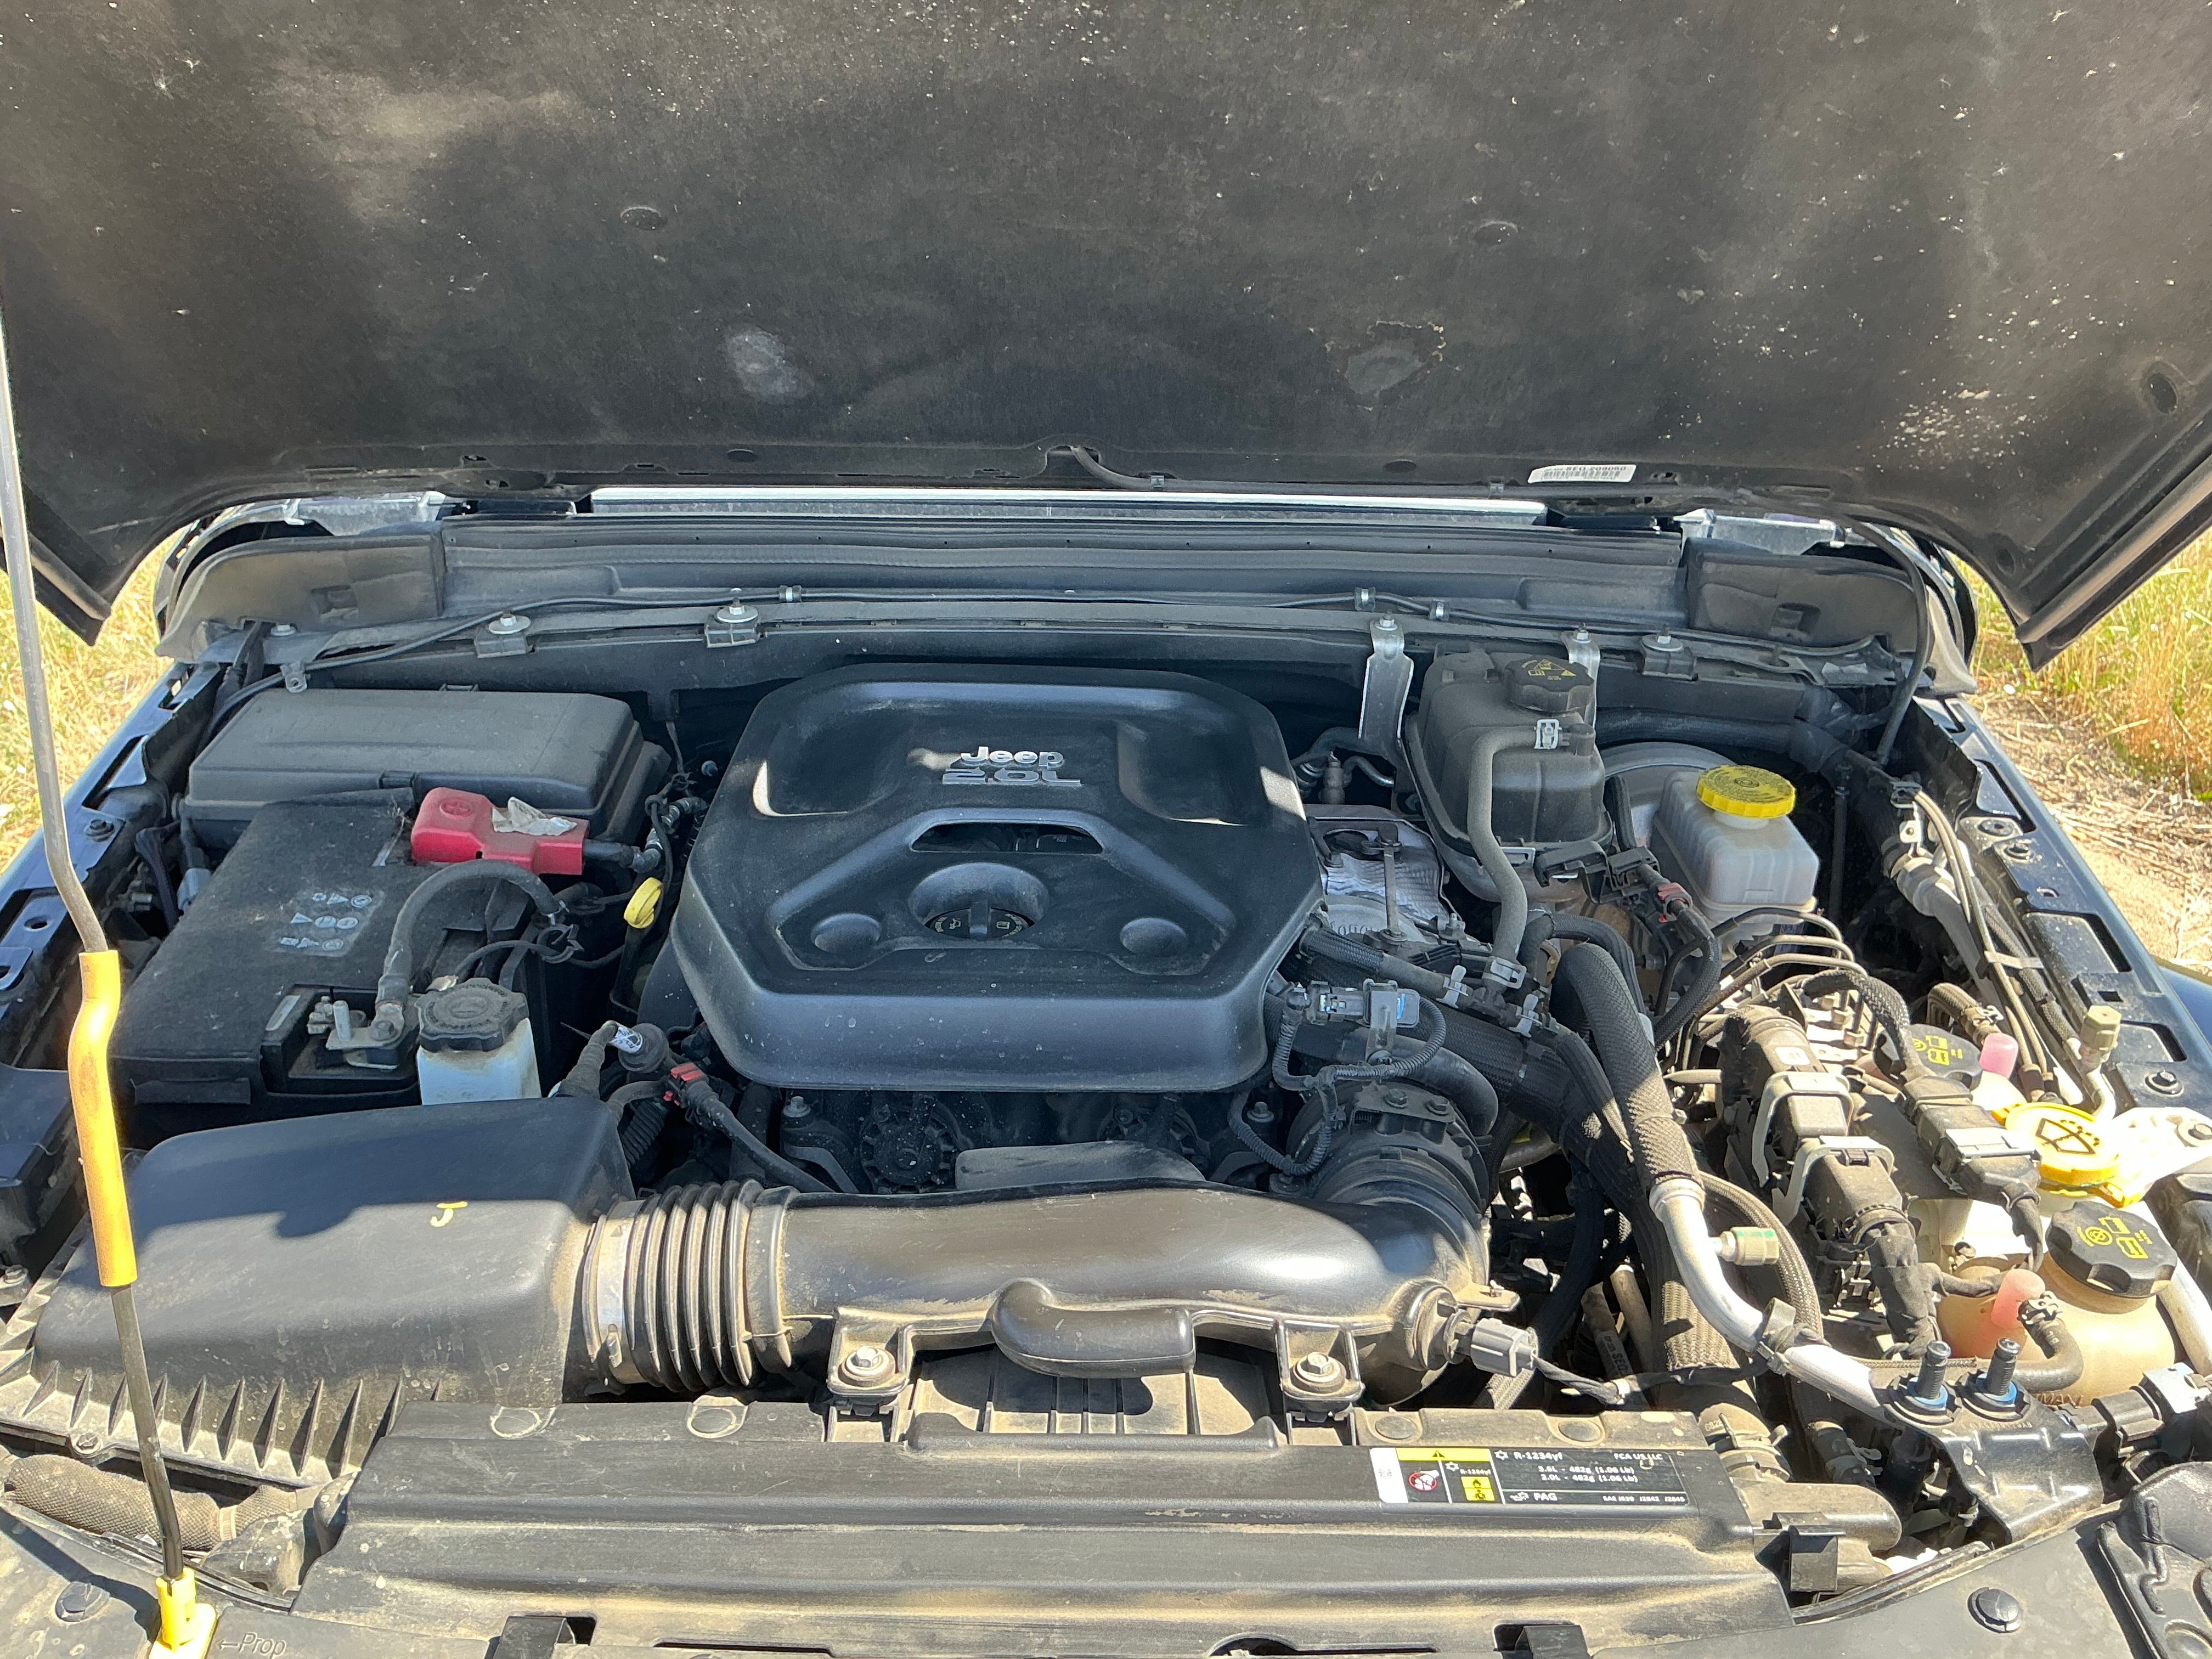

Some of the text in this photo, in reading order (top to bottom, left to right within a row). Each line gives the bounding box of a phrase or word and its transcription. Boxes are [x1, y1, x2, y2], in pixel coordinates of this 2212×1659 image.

[961, 746, 1063, 768] Jeep
[942, 768, 1082, 785] 2.0L
[1533, 1492, 1558, 1501] PAG
[239, 1632, 287, 1659] Prop
